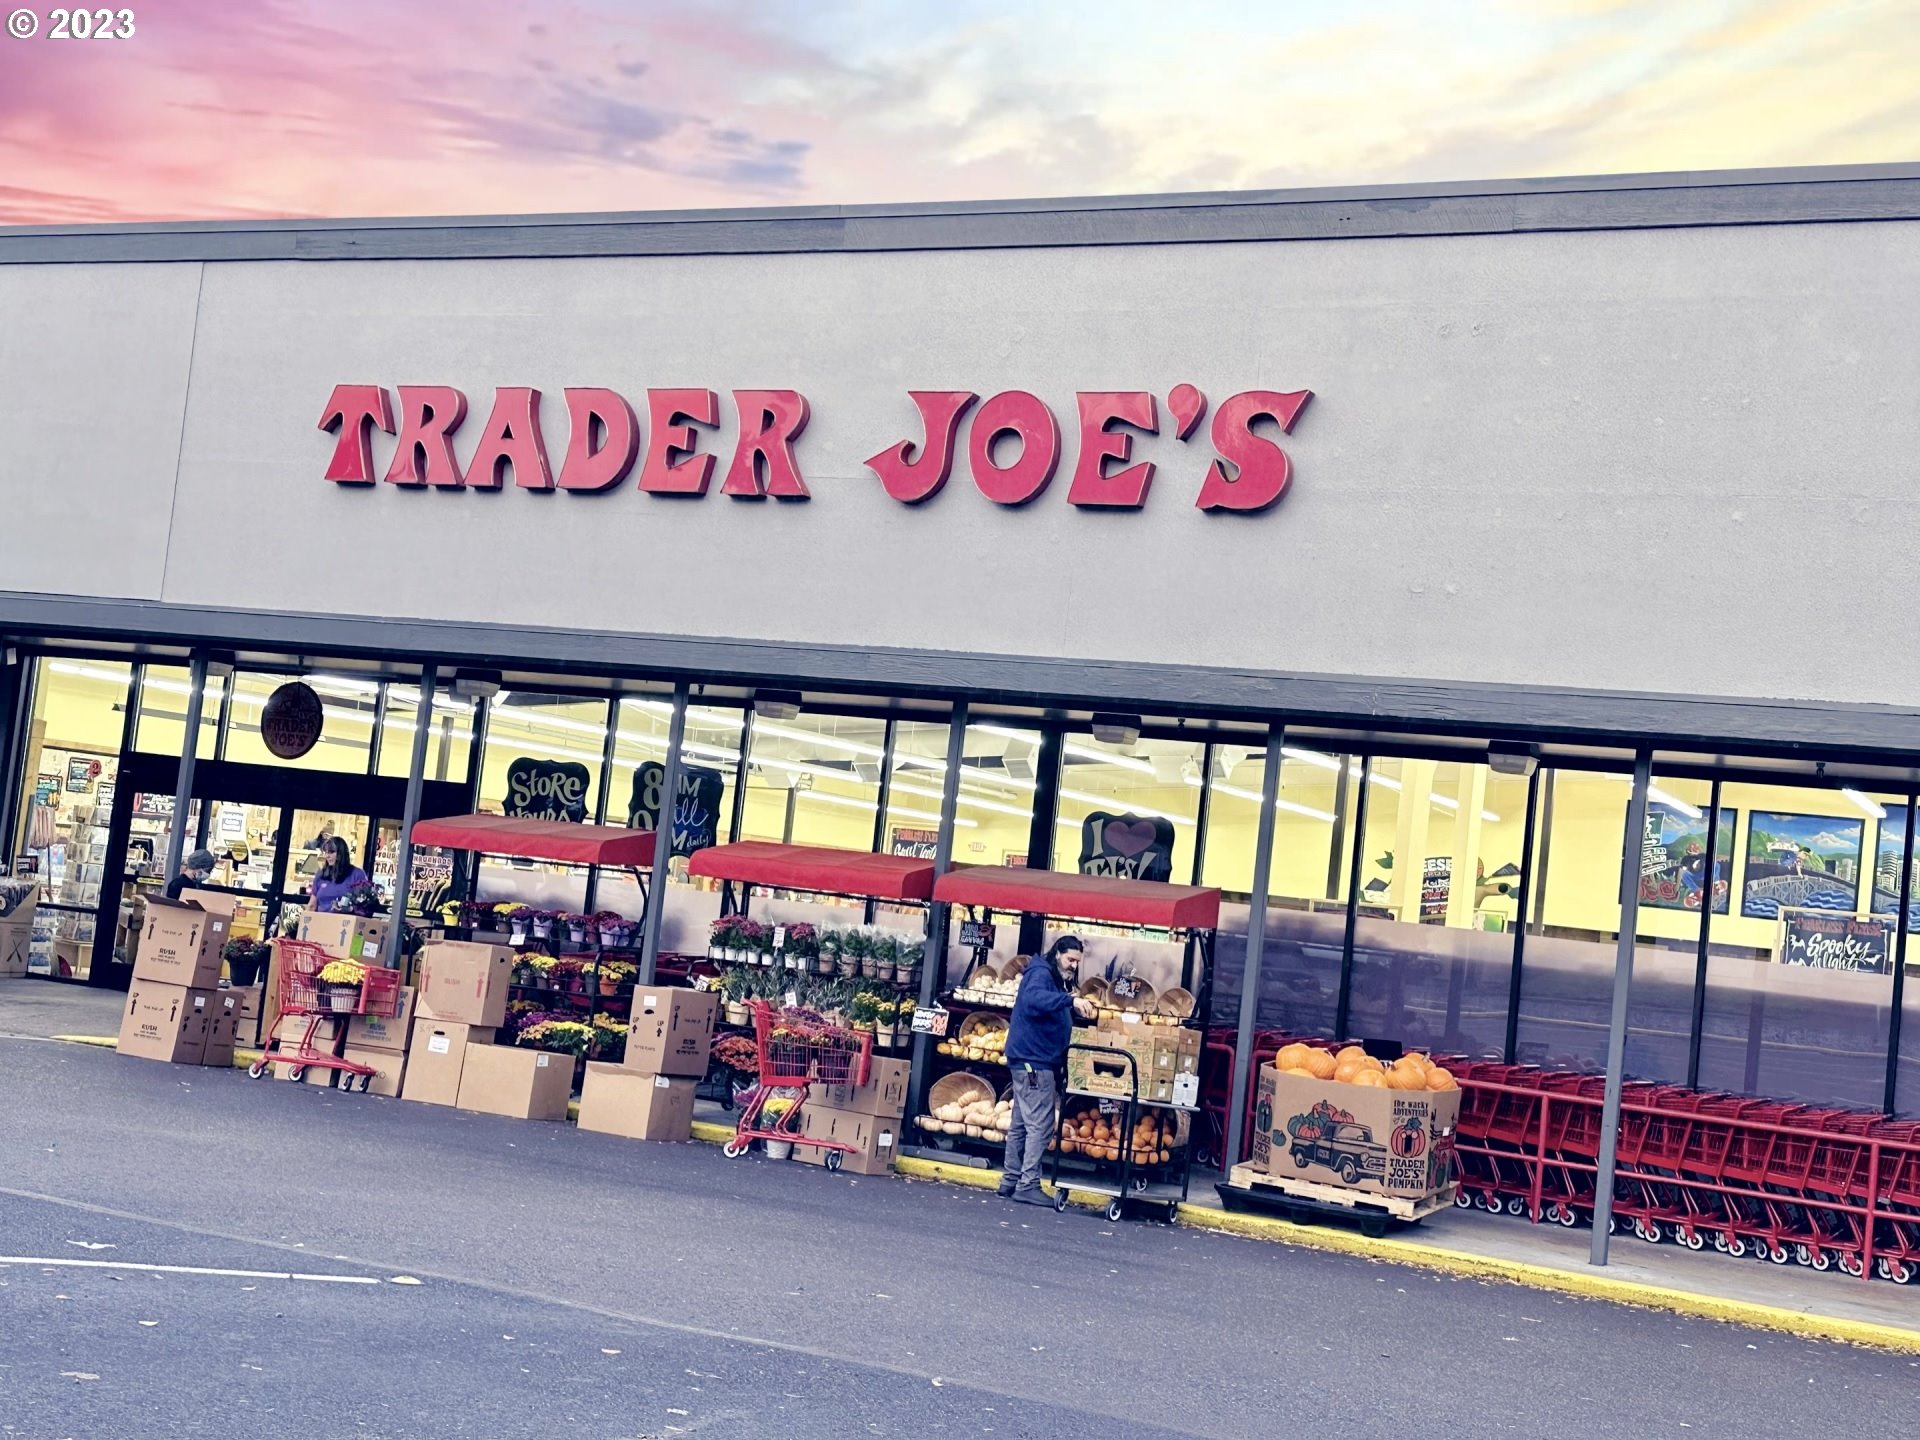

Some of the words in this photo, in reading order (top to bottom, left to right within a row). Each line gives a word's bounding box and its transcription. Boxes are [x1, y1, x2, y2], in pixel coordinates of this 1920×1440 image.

[318, 384, 811, 500] TRADER
[863, 383, 1316, 513] JOE'S
[643, 767, 663, 810] 8
[1090, 818, 1104, 858] I
[1806, 932, 1871, 959] Spooky
[1388, 1166, 1421, 1179] JOE'S
[1389, 1157, 1425, 1169] TRADER
[1387, 1177, 1424, 1190] PUMPKIN
